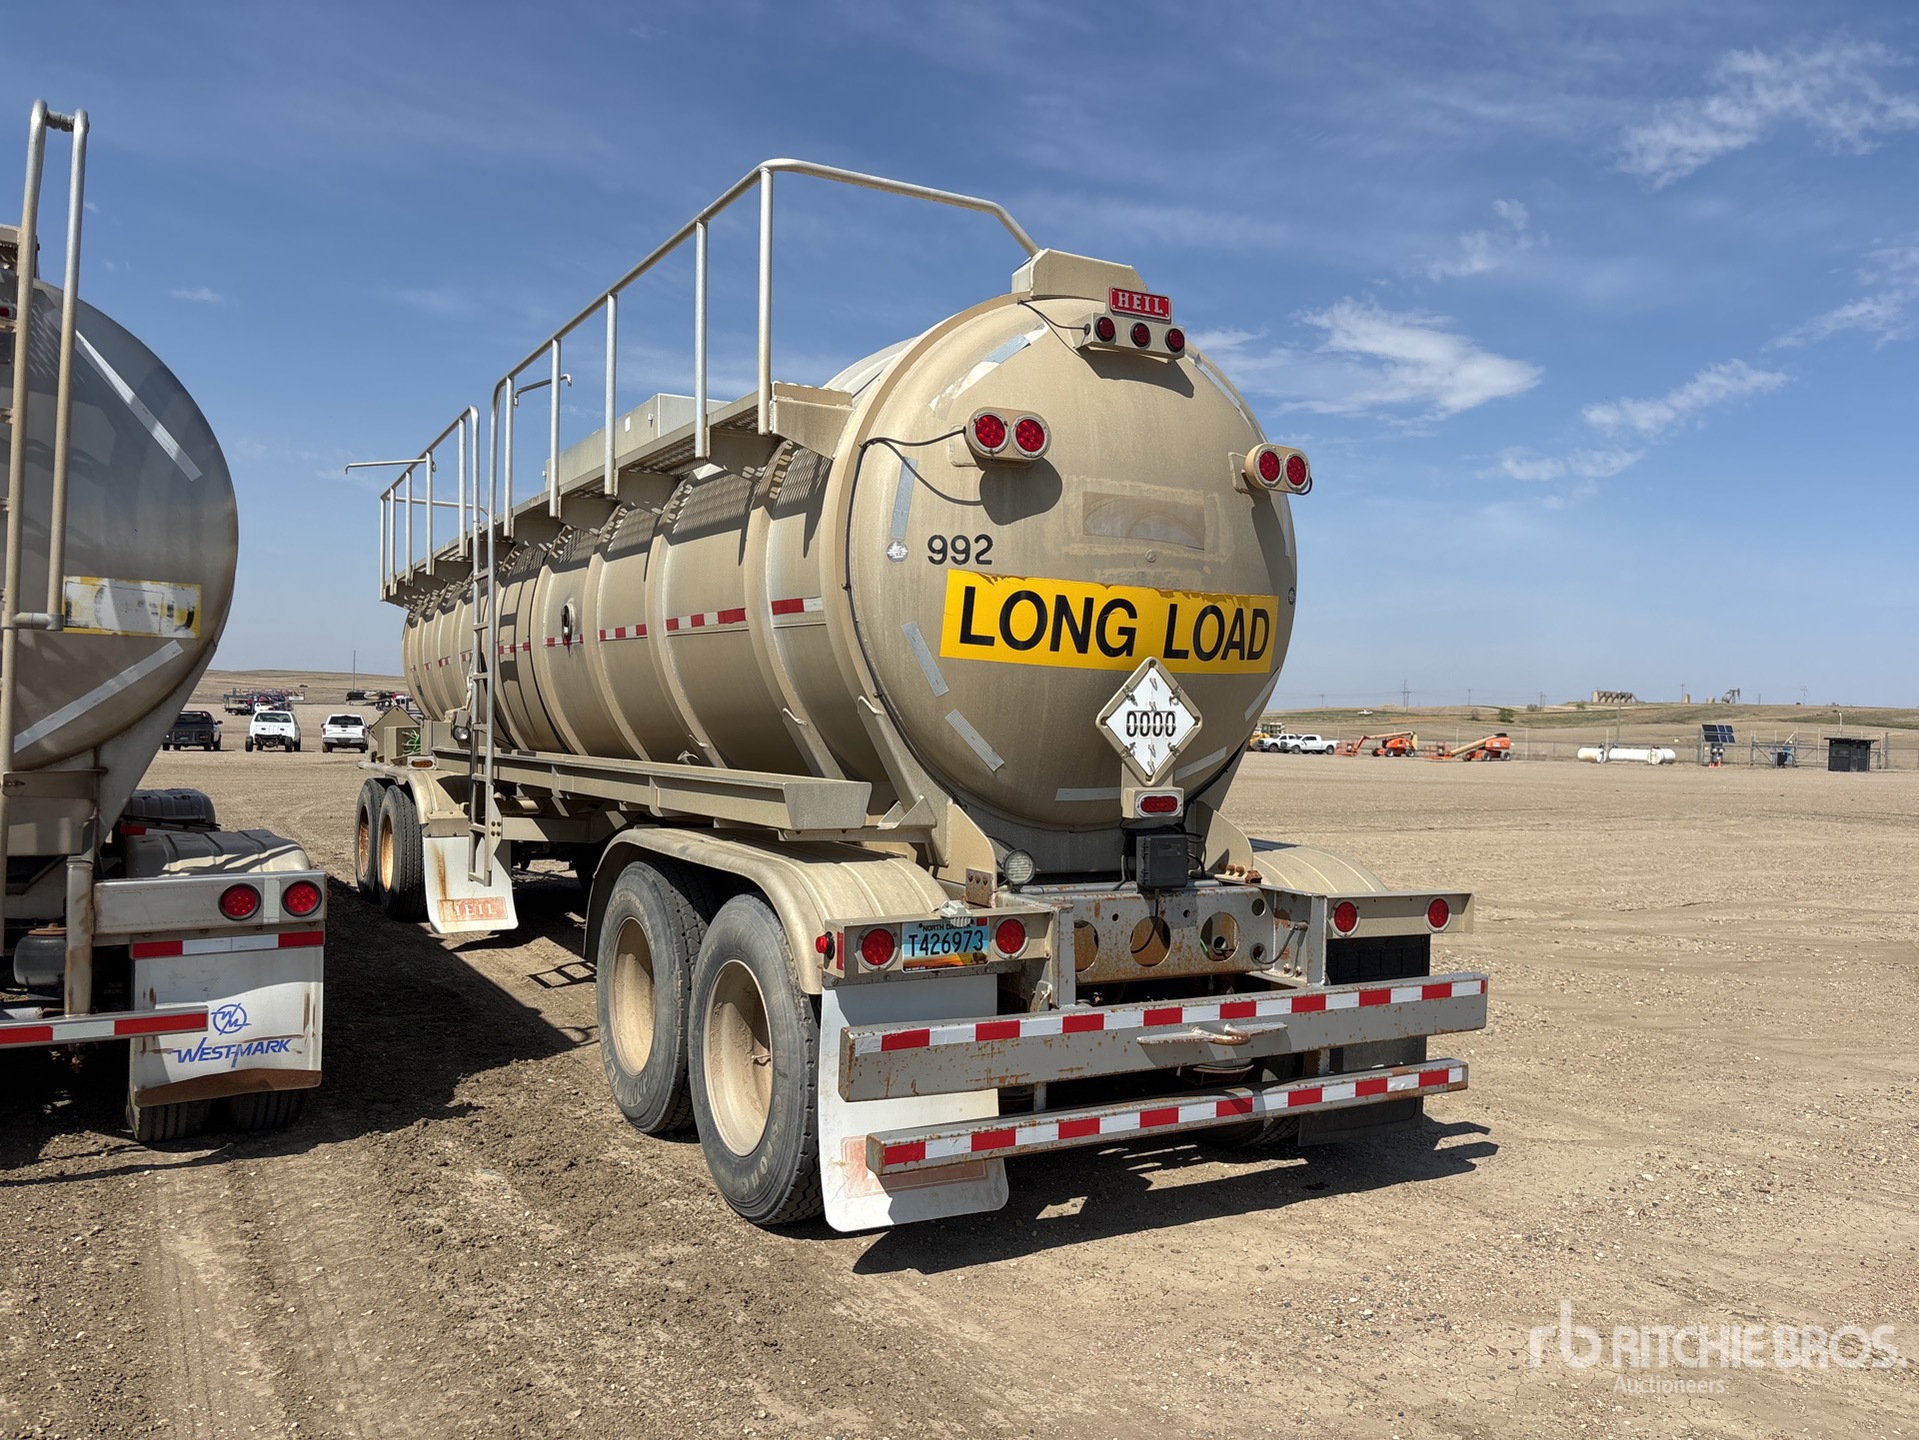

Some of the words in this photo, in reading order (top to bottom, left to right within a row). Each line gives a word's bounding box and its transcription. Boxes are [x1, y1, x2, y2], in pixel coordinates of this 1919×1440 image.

[1117, 291, 1164, 314] HEIL
[927, 534, 994, 565] 992
[959, 586, 1138, 657] LONG
[1163, 603, 1270, 662] LOAD
[1126, 711, 1176, 737] 0000
[908, 929, 983, 957] T426973
